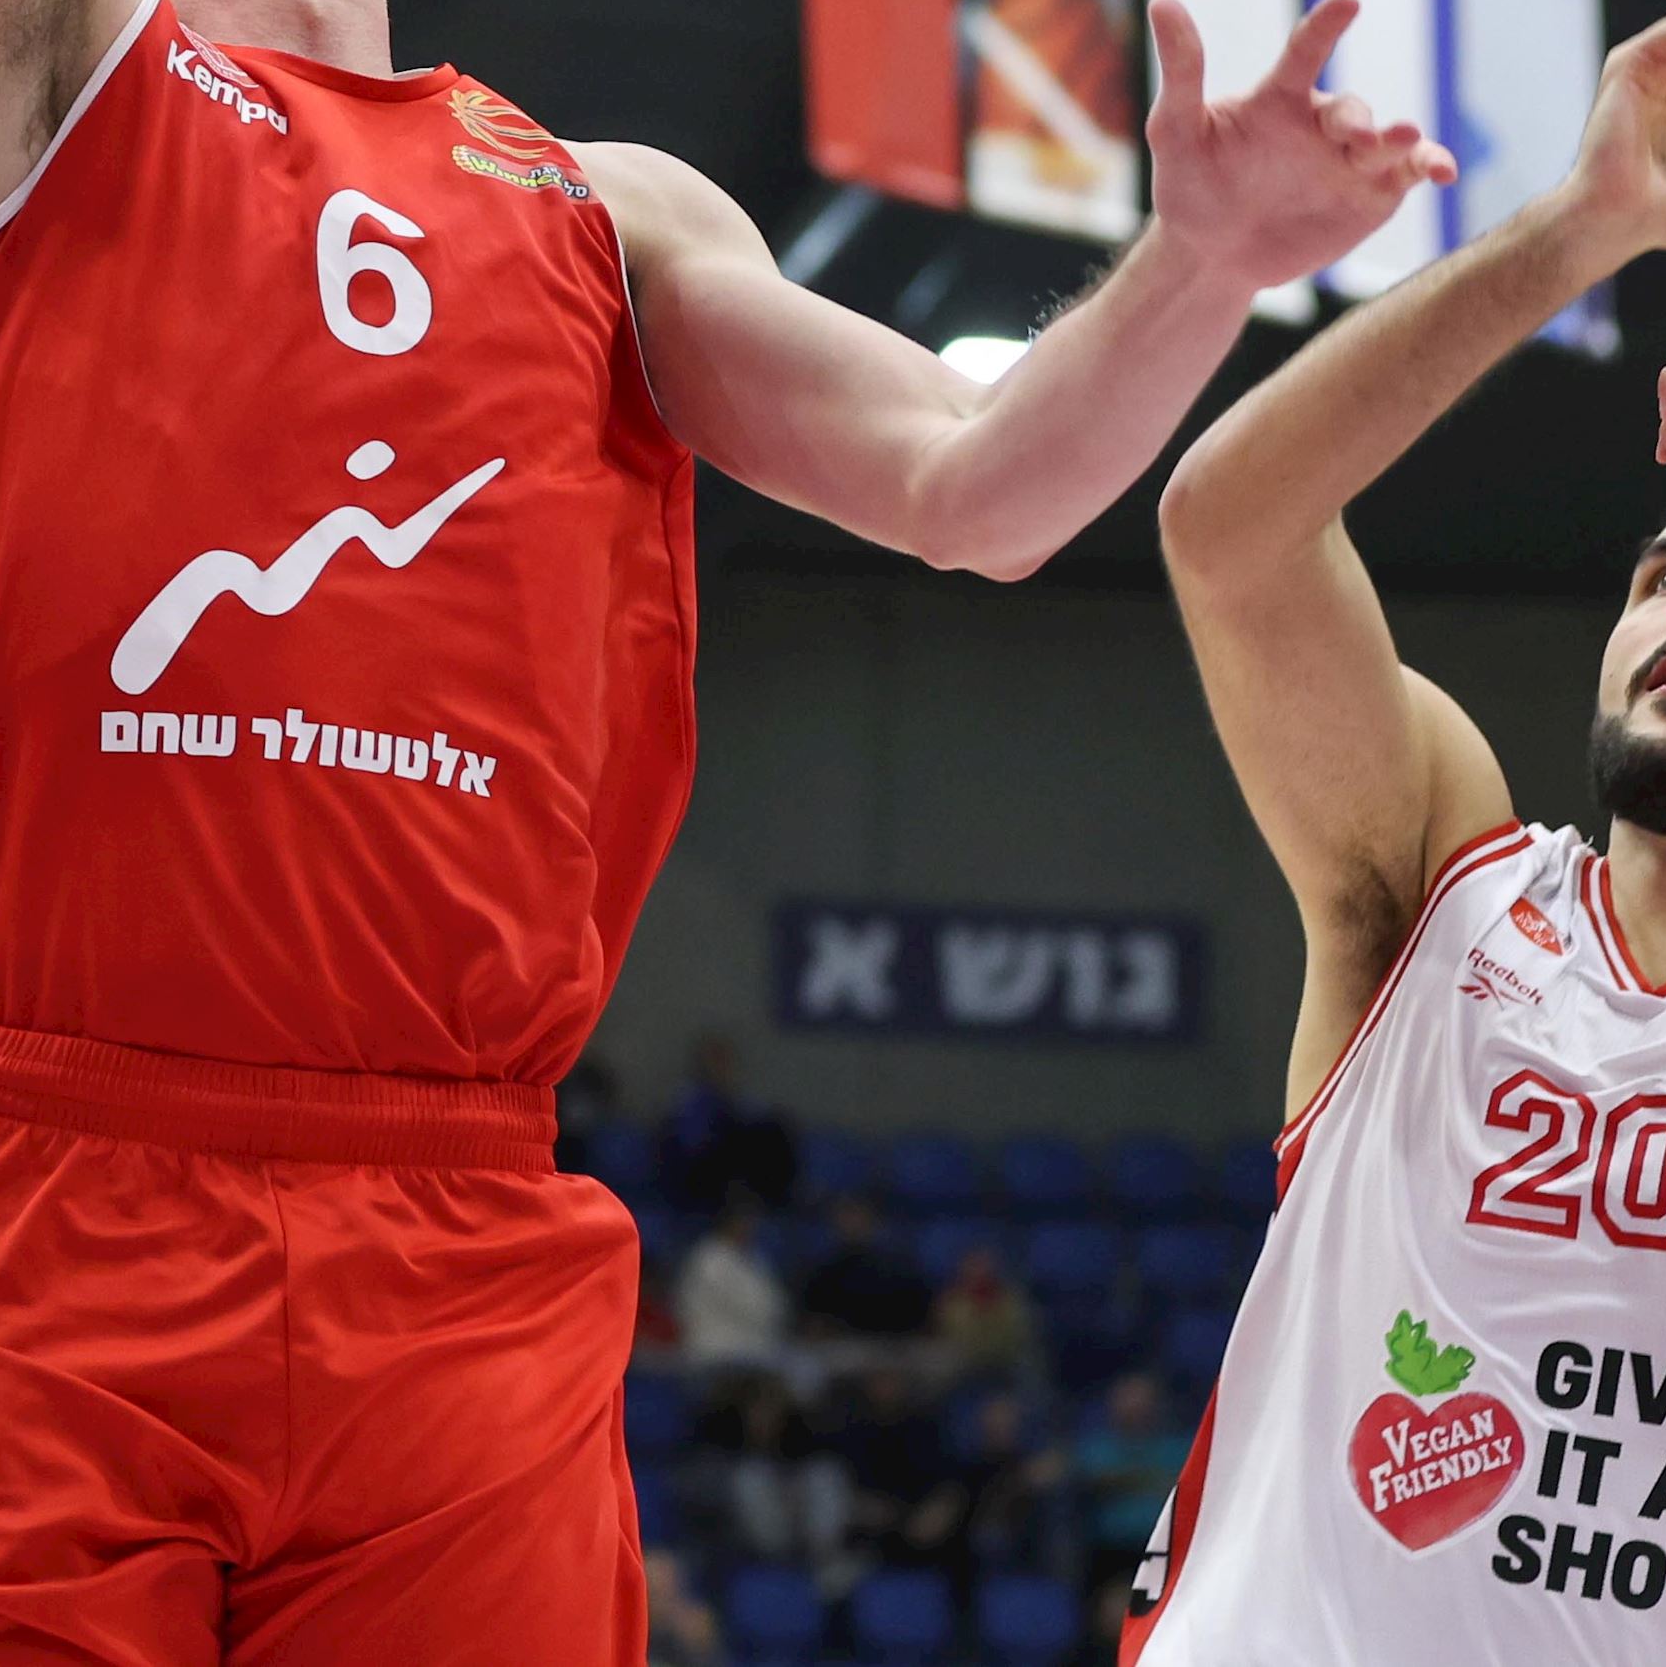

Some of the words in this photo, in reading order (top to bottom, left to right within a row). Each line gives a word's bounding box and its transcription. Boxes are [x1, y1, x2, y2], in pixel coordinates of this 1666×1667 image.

[166, 38, 288, 136] Kempa
[315, 187, 433, 357] 6
[100, 710, 237, 758] שחם
[250, 707, 497, 799] אלטשולר
[797, 916, 901, 1020] א
[940, 926, 1178, 1032] גוש
[1467, 946, 1544, 1006] Reebok
[1536, 1429, 1623, 1508] IT
